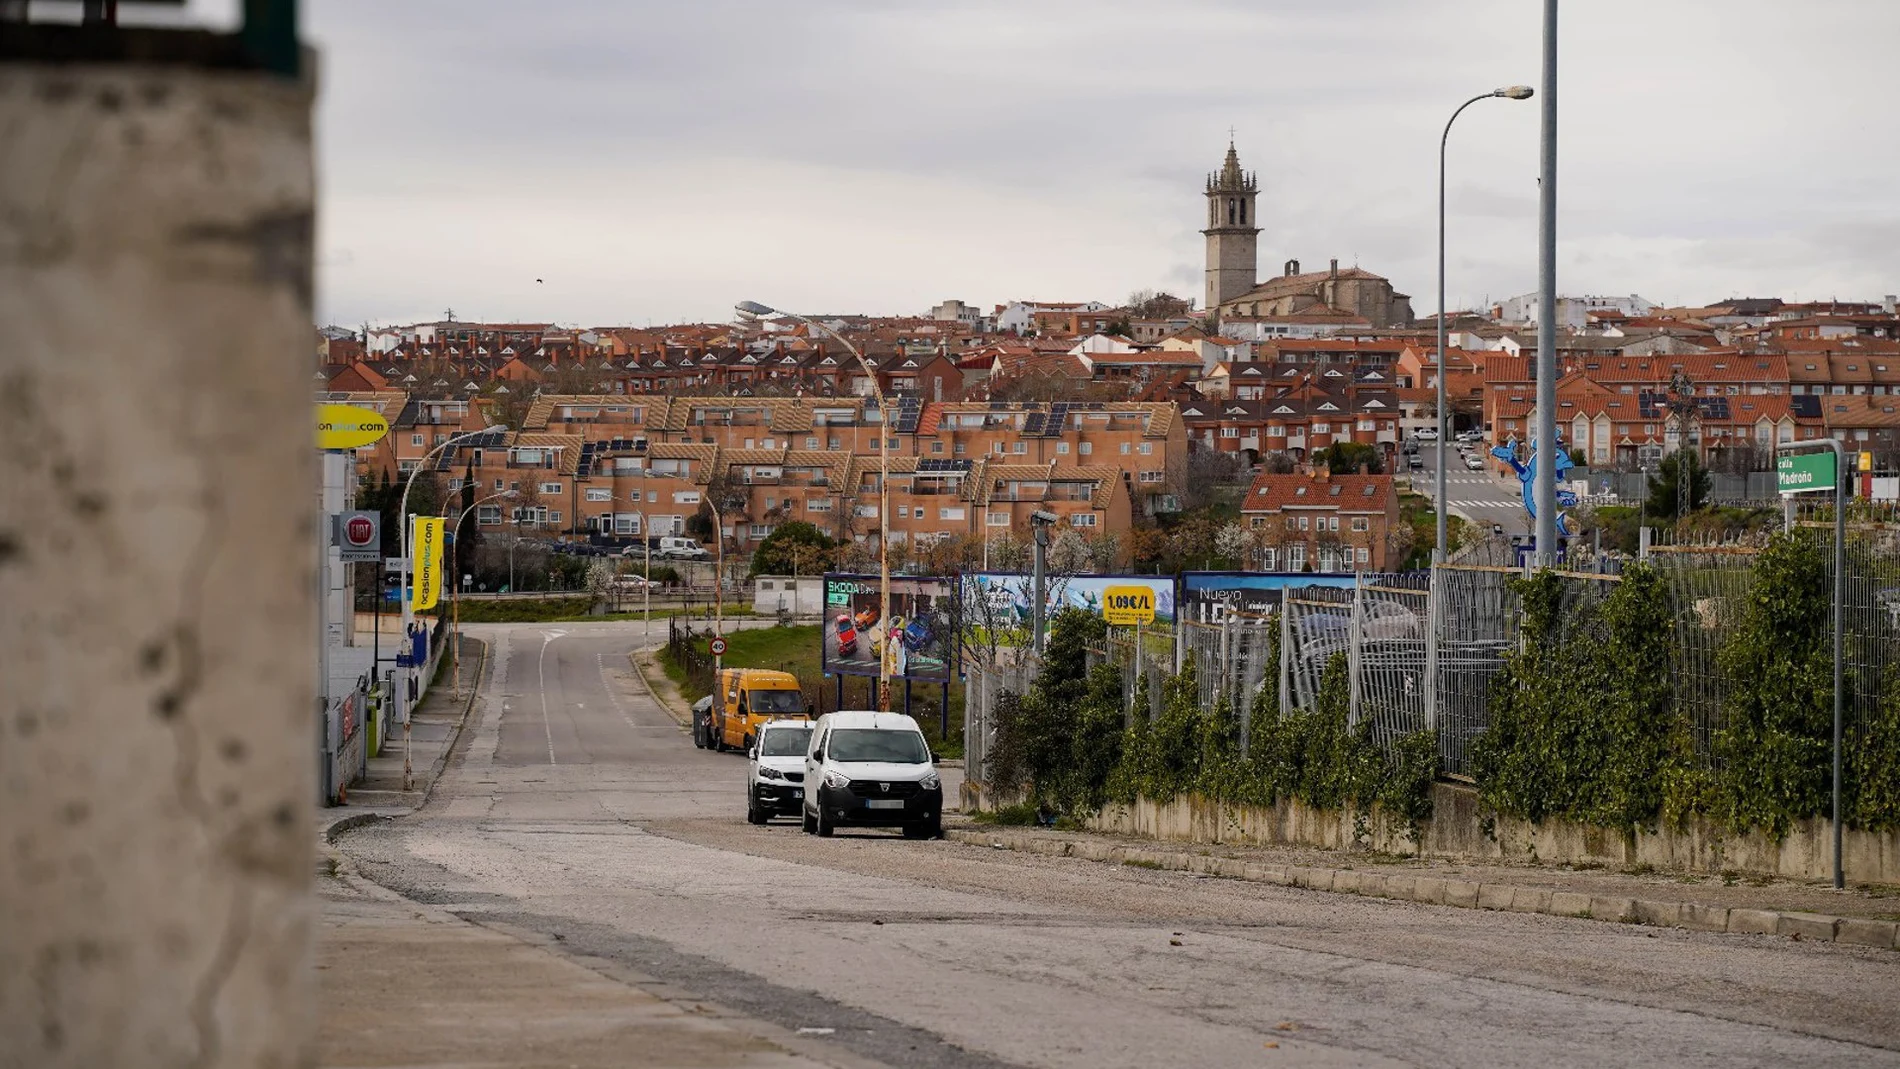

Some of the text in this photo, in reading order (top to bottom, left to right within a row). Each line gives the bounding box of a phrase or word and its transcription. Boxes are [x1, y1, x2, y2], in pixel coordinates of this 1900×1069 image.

[1778, 459, 1793, 469] calle
[1779, 471, 1812, 484] Madroño
[350, 523, 370, 540] FIAT
[421, 522, 433, 604] ocasionplus.com
[1200, 586, 1242, 601] Nuevo
